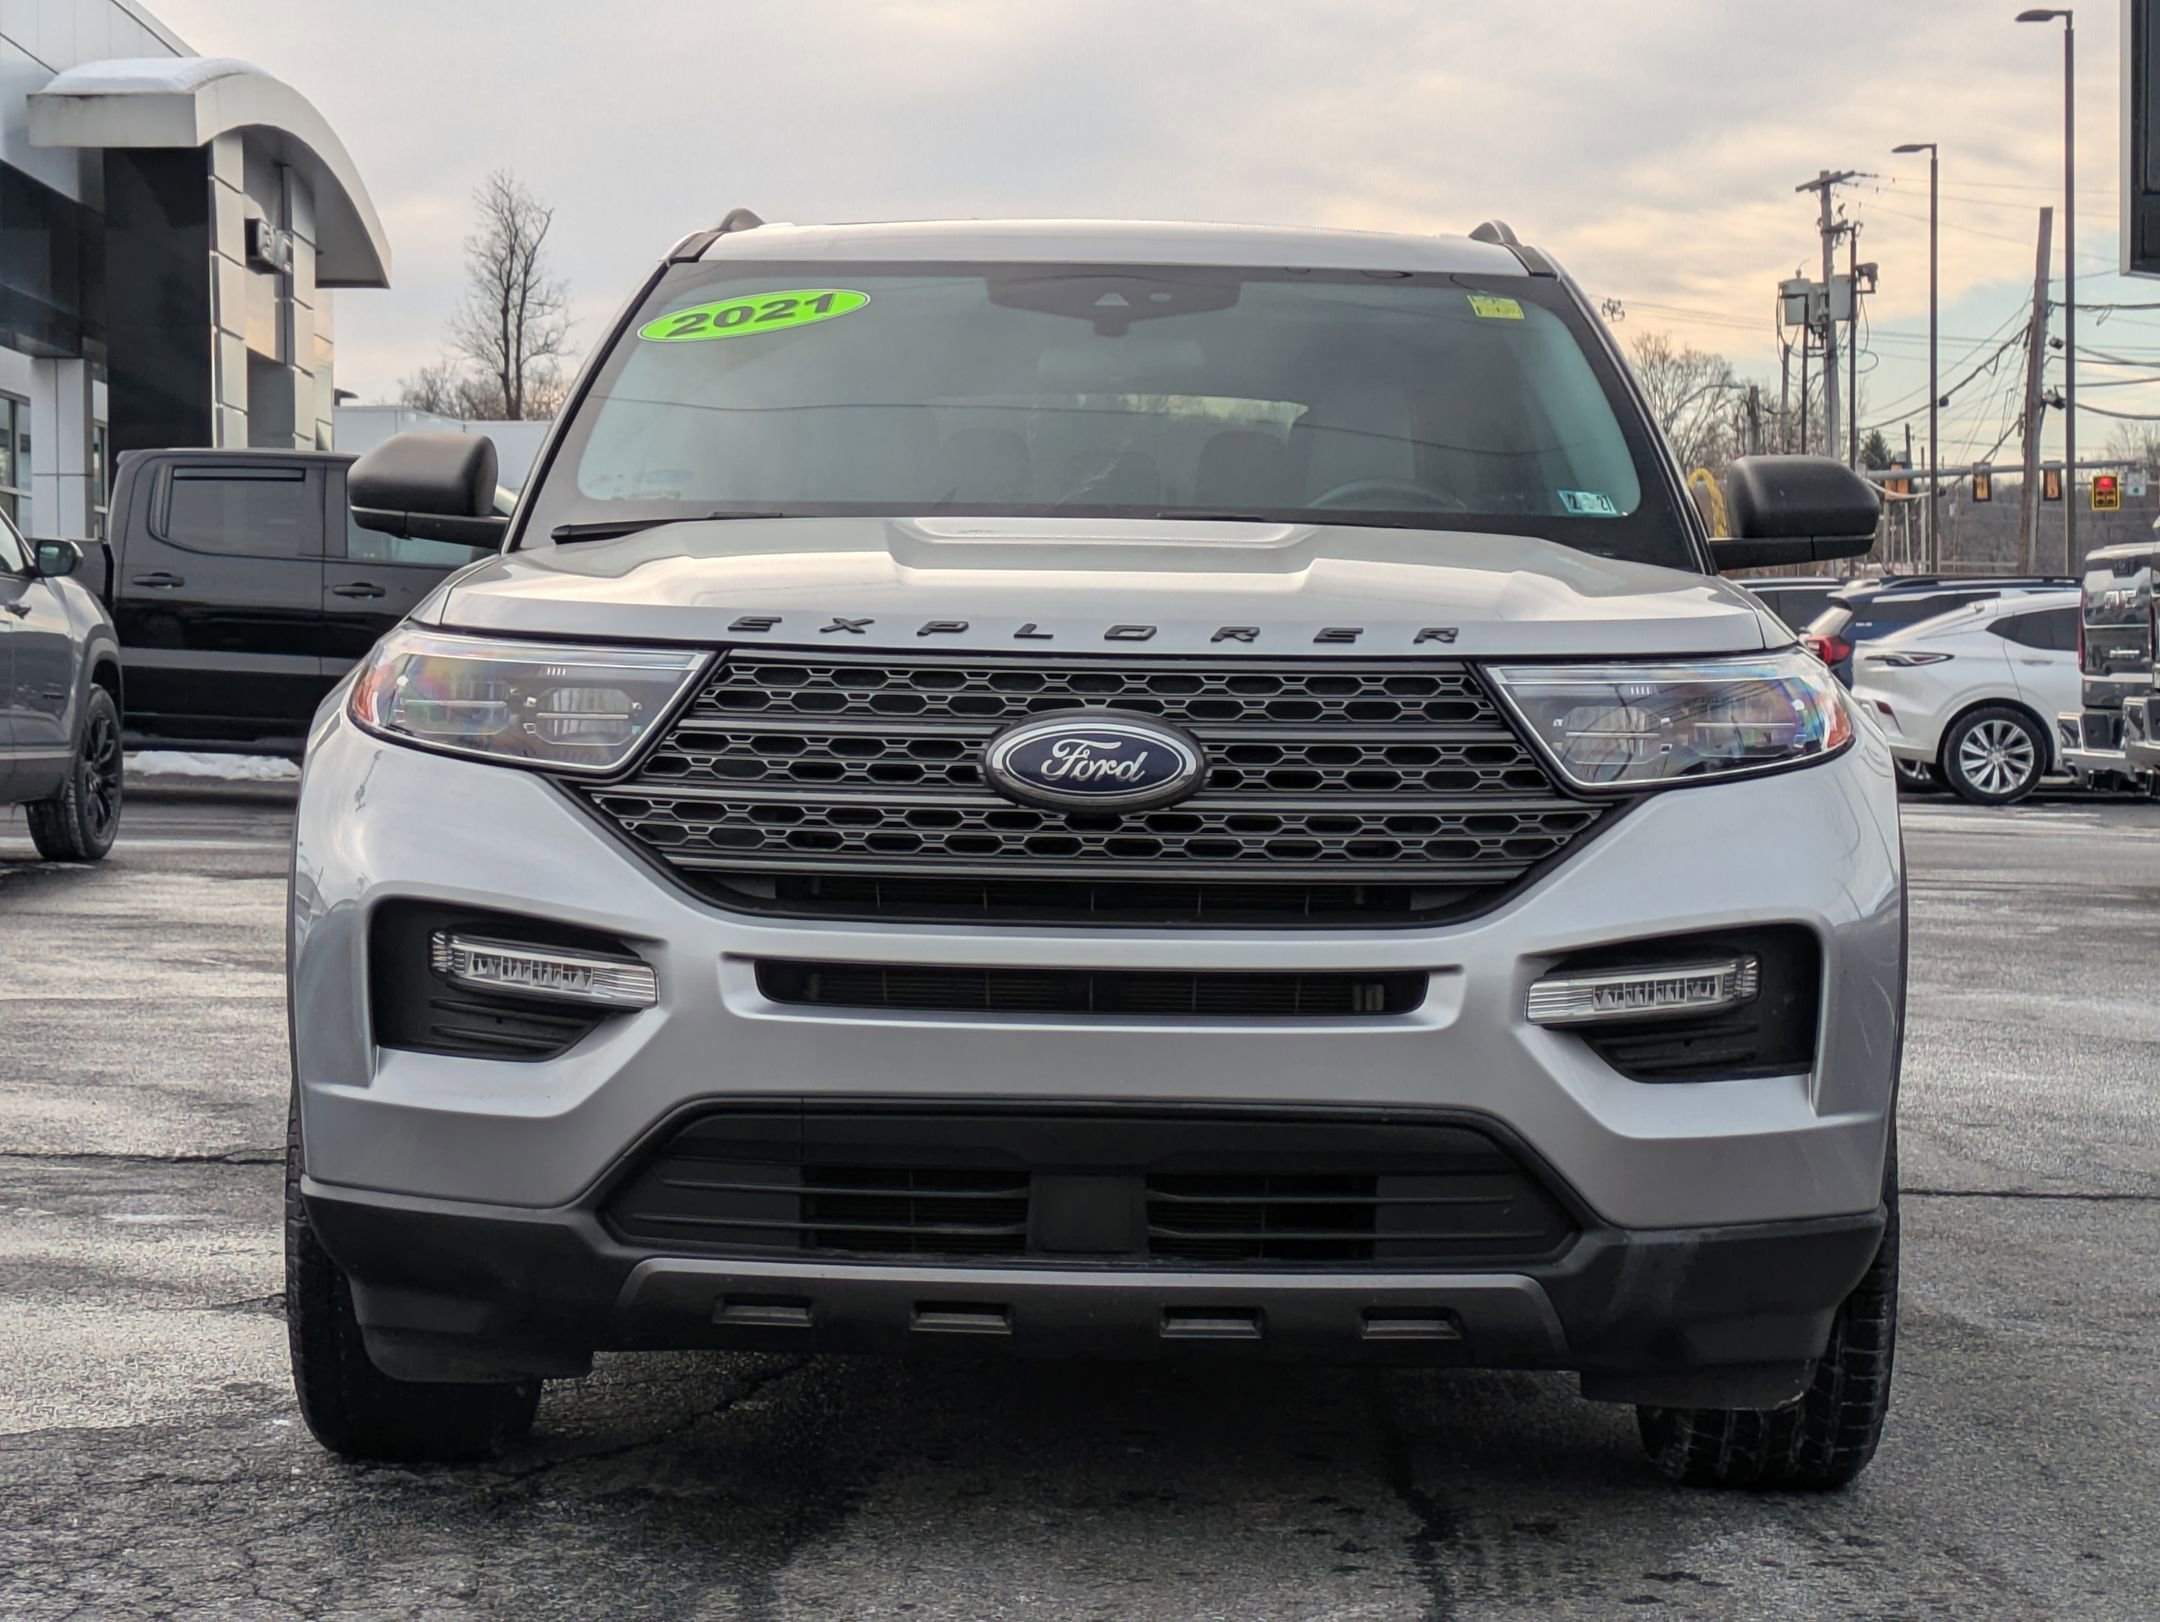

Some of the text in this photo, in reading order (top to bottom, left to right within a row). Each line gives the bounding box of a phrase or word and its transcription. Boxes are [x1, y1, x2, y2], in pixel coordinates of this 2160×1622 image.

[665, 292, 836, 338] 2021
[728, 615, 1460, 644] EXPLORER
[1040, 738, 1149, 783] Ford
